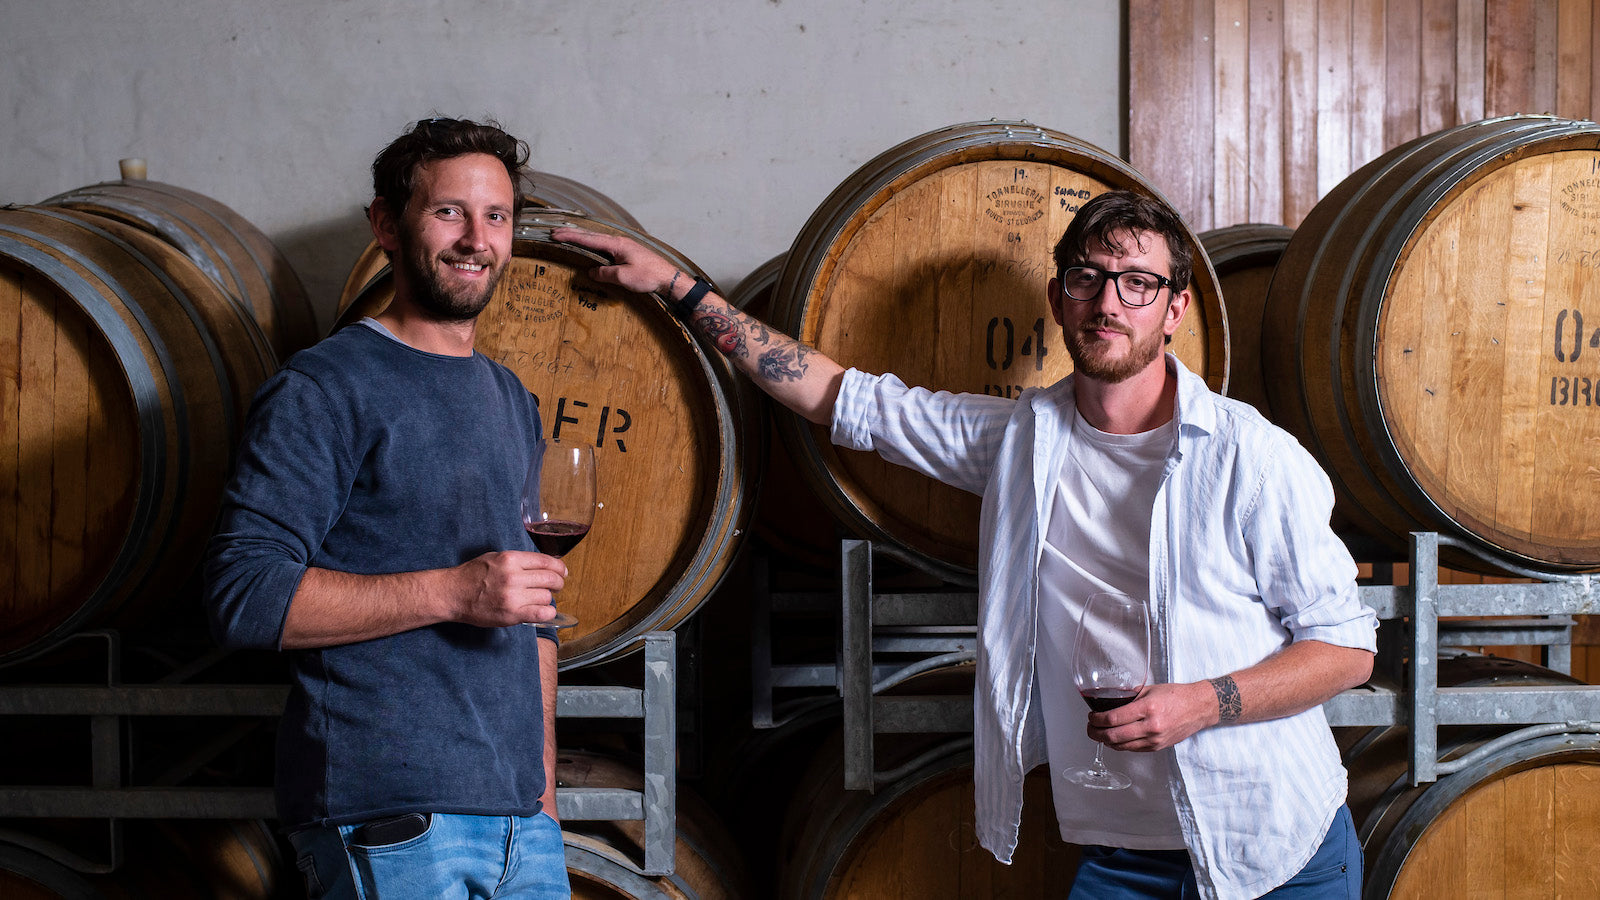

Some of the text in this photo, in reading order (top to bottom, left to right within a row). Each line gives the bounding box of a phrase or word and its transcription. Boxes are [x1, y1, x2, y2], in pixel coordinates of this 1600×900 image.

[995, 199, 1035, 210] SIRUGUE
[1582, 225, 1597, 236] 04
[1007, 232, 1021, 243] 04
[534, 264, 546, 279] 18
[515, 293, 555, 309] SIRUGUE
[523, 327, 537, 338] 04
[986, 317, 1048, 371] 04
[1550, 376, 1600, 406] BR
